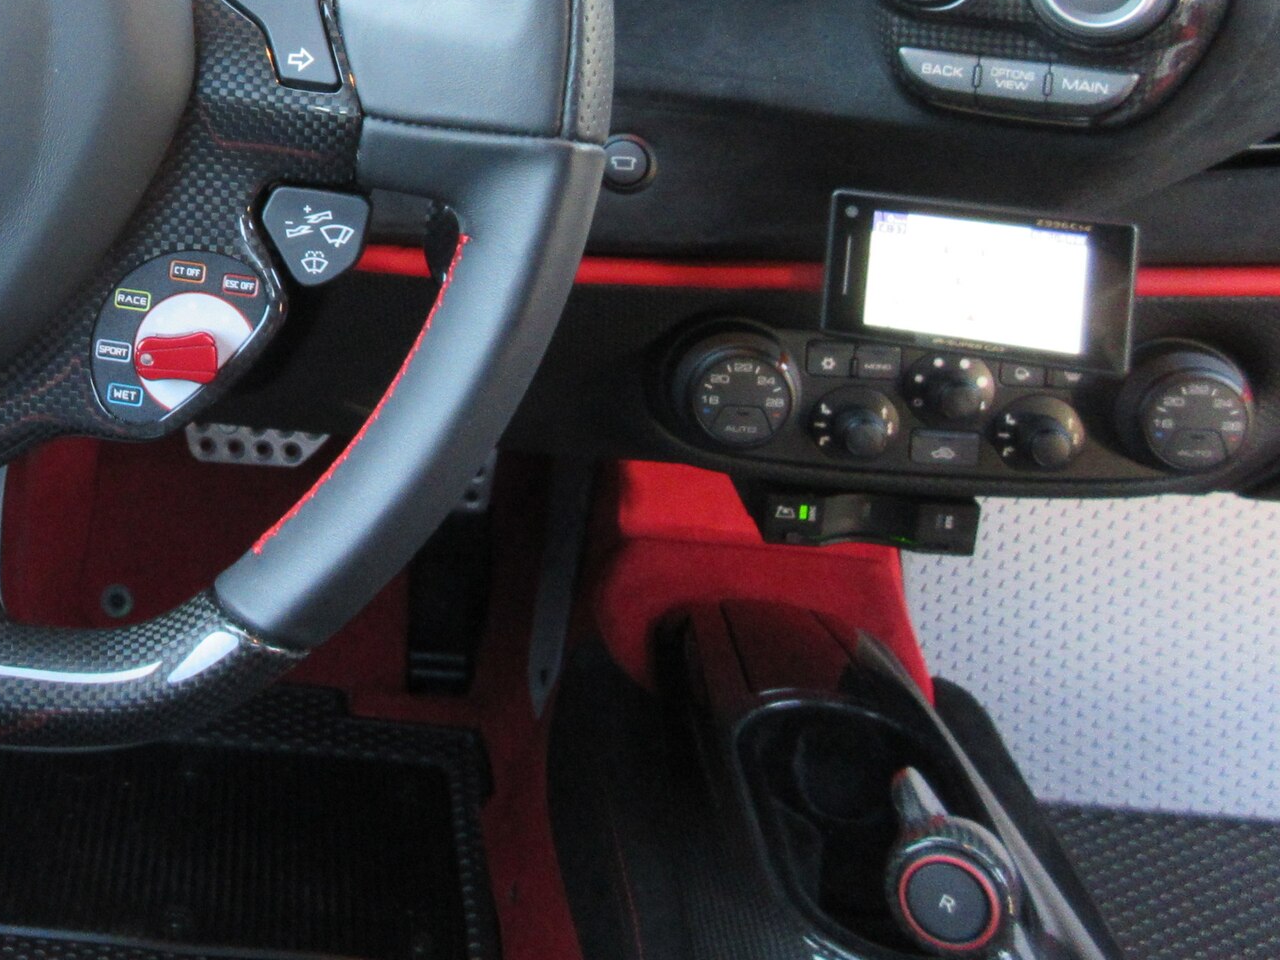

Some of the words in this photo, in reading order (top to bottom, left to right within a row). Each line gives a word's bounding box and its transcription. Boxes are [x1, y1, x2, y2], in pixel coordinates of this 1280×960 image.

[921, 62, 964, 78] BACK
[994, 79, 1030, 91] VIEW
[1061, 78, 1110, 96] MAIN
[174, 266, 185, 274] CT
[186, 266, 201, 278] OFF
[240, 281, 255, 291] OFF
[117, 293, 147, 307] RACE
[98, 344, 128, 358] SPORT
[734, 362, 753, 372] 22
[710, 374, 730, 384] 20
[757, 376, 776, 386] 24
[113, 388, 137, 401] WET
[938, 894, 956, 913] R
